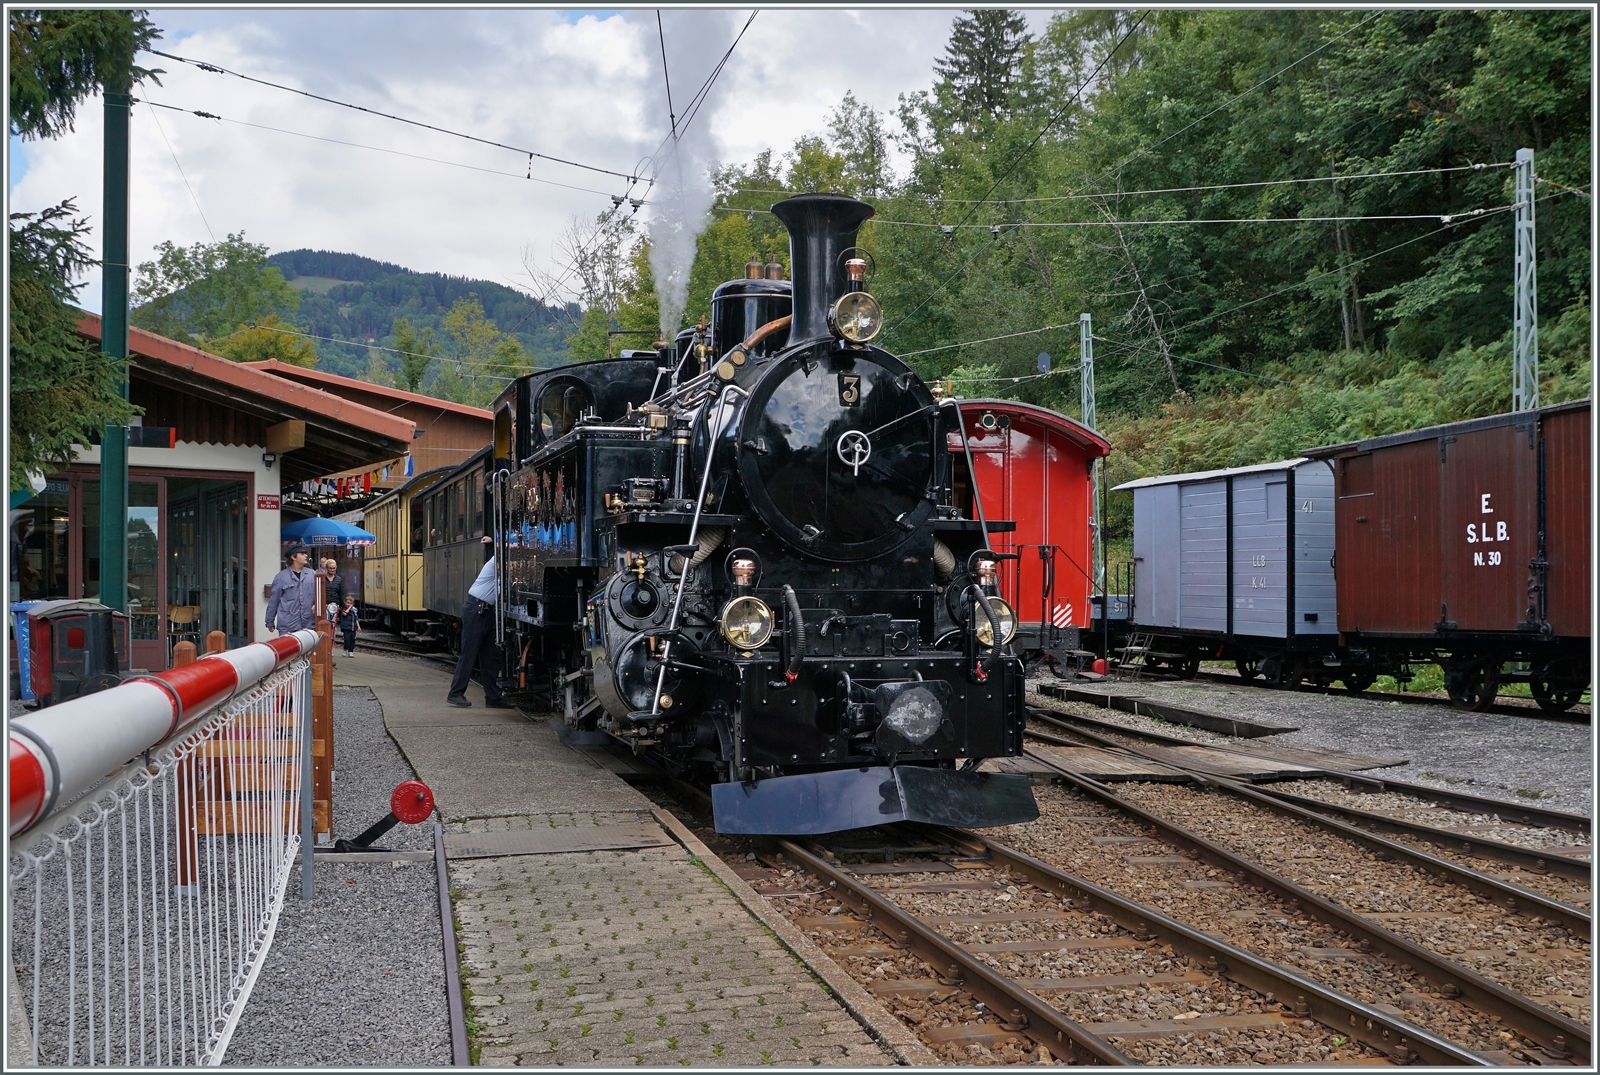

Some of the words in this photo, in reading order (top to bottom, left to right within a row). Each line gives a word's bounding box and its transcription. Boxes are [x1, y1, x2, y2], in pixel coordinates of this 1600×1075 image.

[842, 376, 859, 403] 3
[1302, 500, 1314, 513] 41
[1481, 493, 1494, 514] E.
[1473, 552, 1486, 566] N.
[1488, 551, 1502, 566] 30
